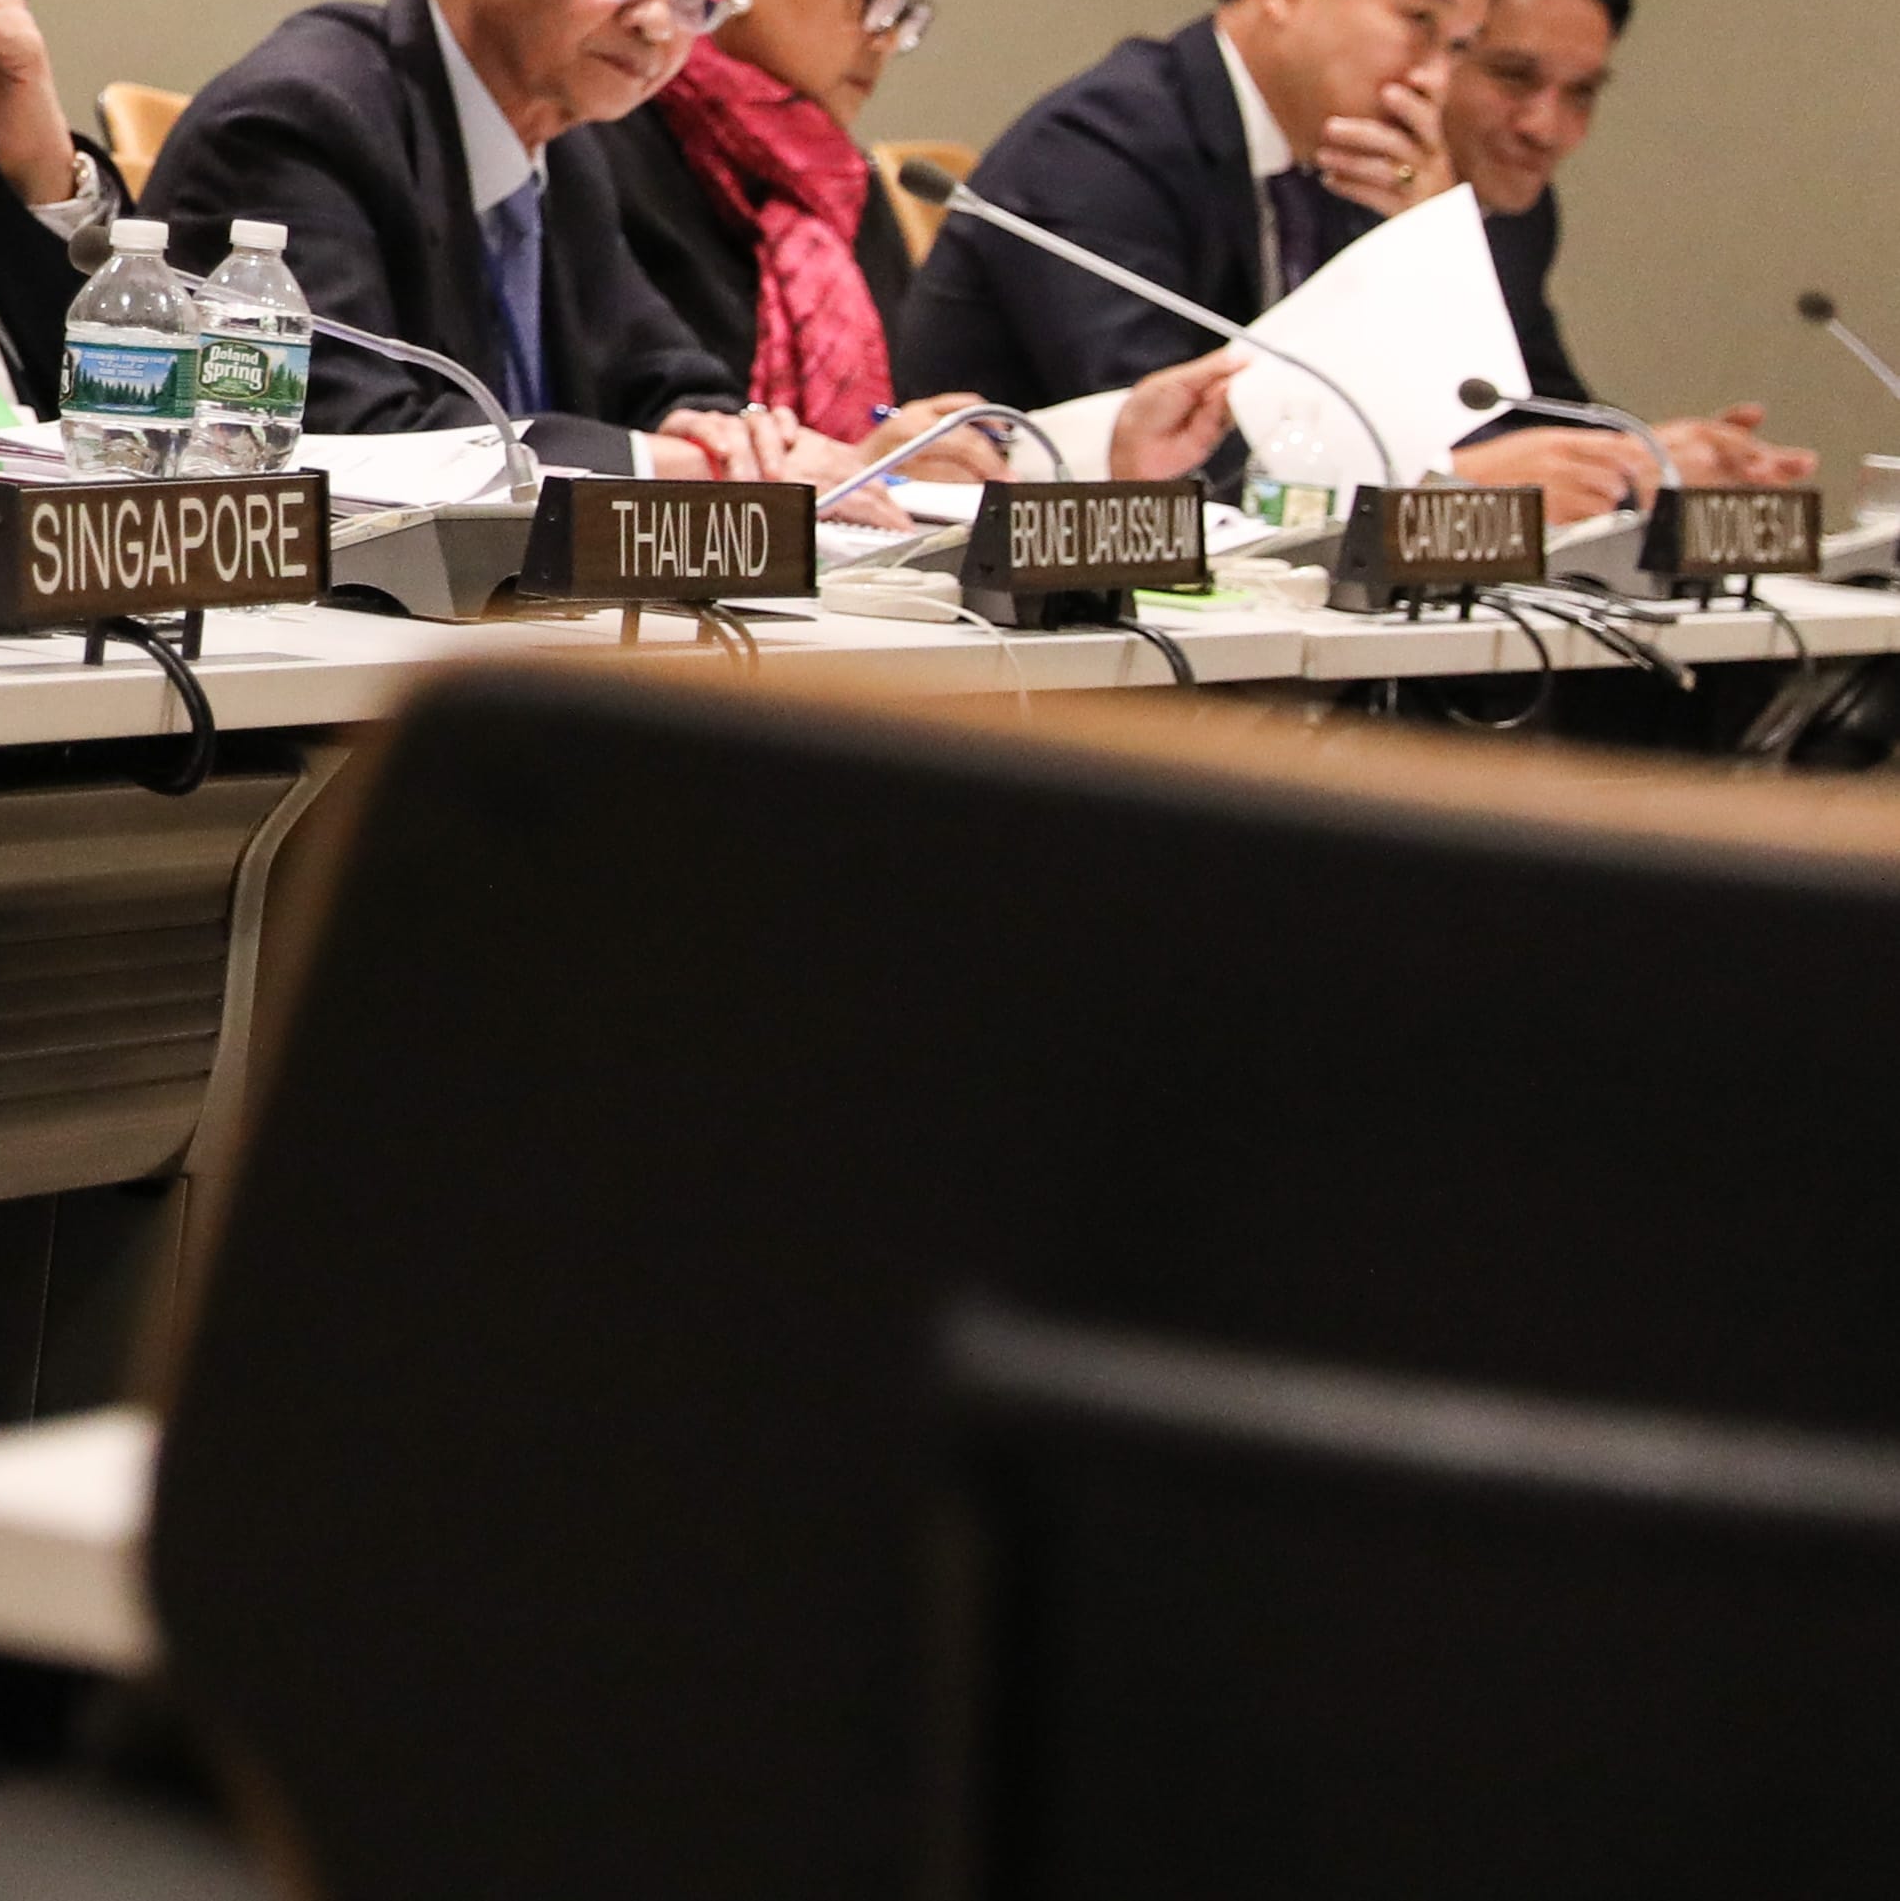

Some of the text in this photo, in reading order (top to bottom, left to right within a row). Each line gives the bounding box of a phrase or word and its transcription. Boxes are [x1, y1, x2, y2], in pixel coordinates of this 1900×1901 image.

[201, 361, 264, 391] Spring
[209, 345, 260, 366] Poland
[31, 491, 308, 595] SINGAPORE
[611, 500, 770, 578] THAILAND
[1010, 494, 1199, 568] BRUNEI DARUSSALAM
